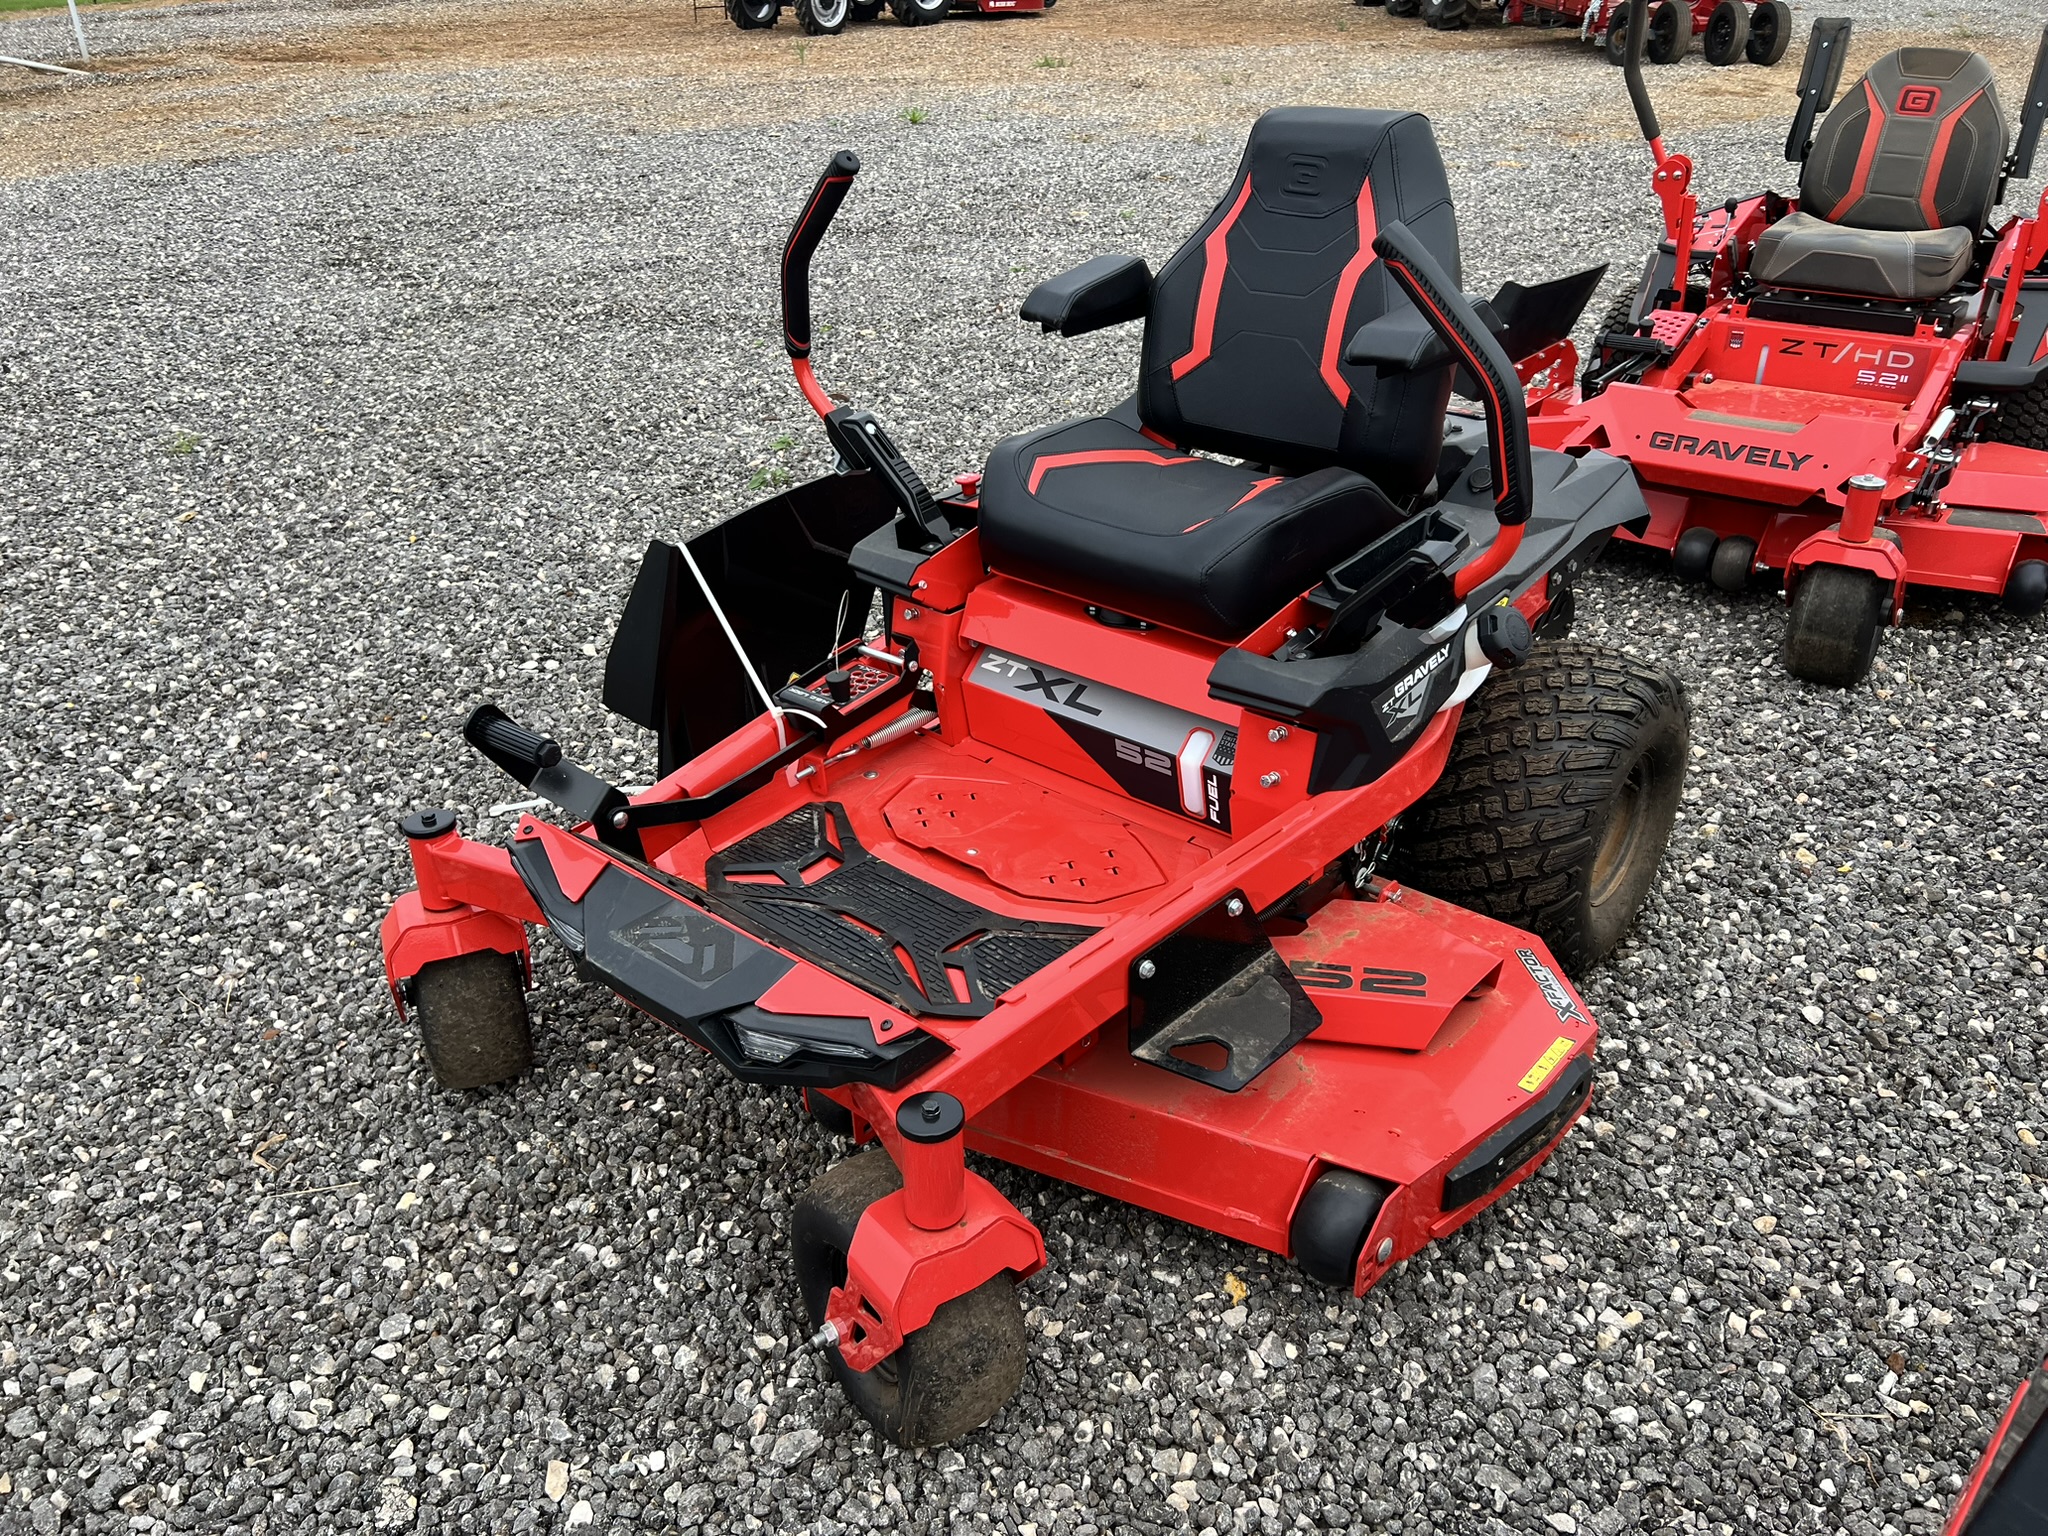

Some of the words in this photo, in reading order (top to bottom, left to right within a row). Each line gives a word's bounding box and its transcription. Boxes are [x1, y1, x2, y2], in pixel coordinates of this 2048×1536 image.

[1778, 338, 1915, 369] ZT/HD
[1649, 431, 1814, 472] GRAVELY
[981, 653, 1028, 678] ZT
[1013, 666, 1102, 717] XL
[1394, 643, 1450, 698] GRAVELY
[1386, 690, 1423, 729] XL
[1114, 738, 1173, 777] 52
[1209, 774, 1221, 824] FUEL
[1289, 960, 1427, 998] 52
[1517, 948, 1590, 1025] X-FACTOR
